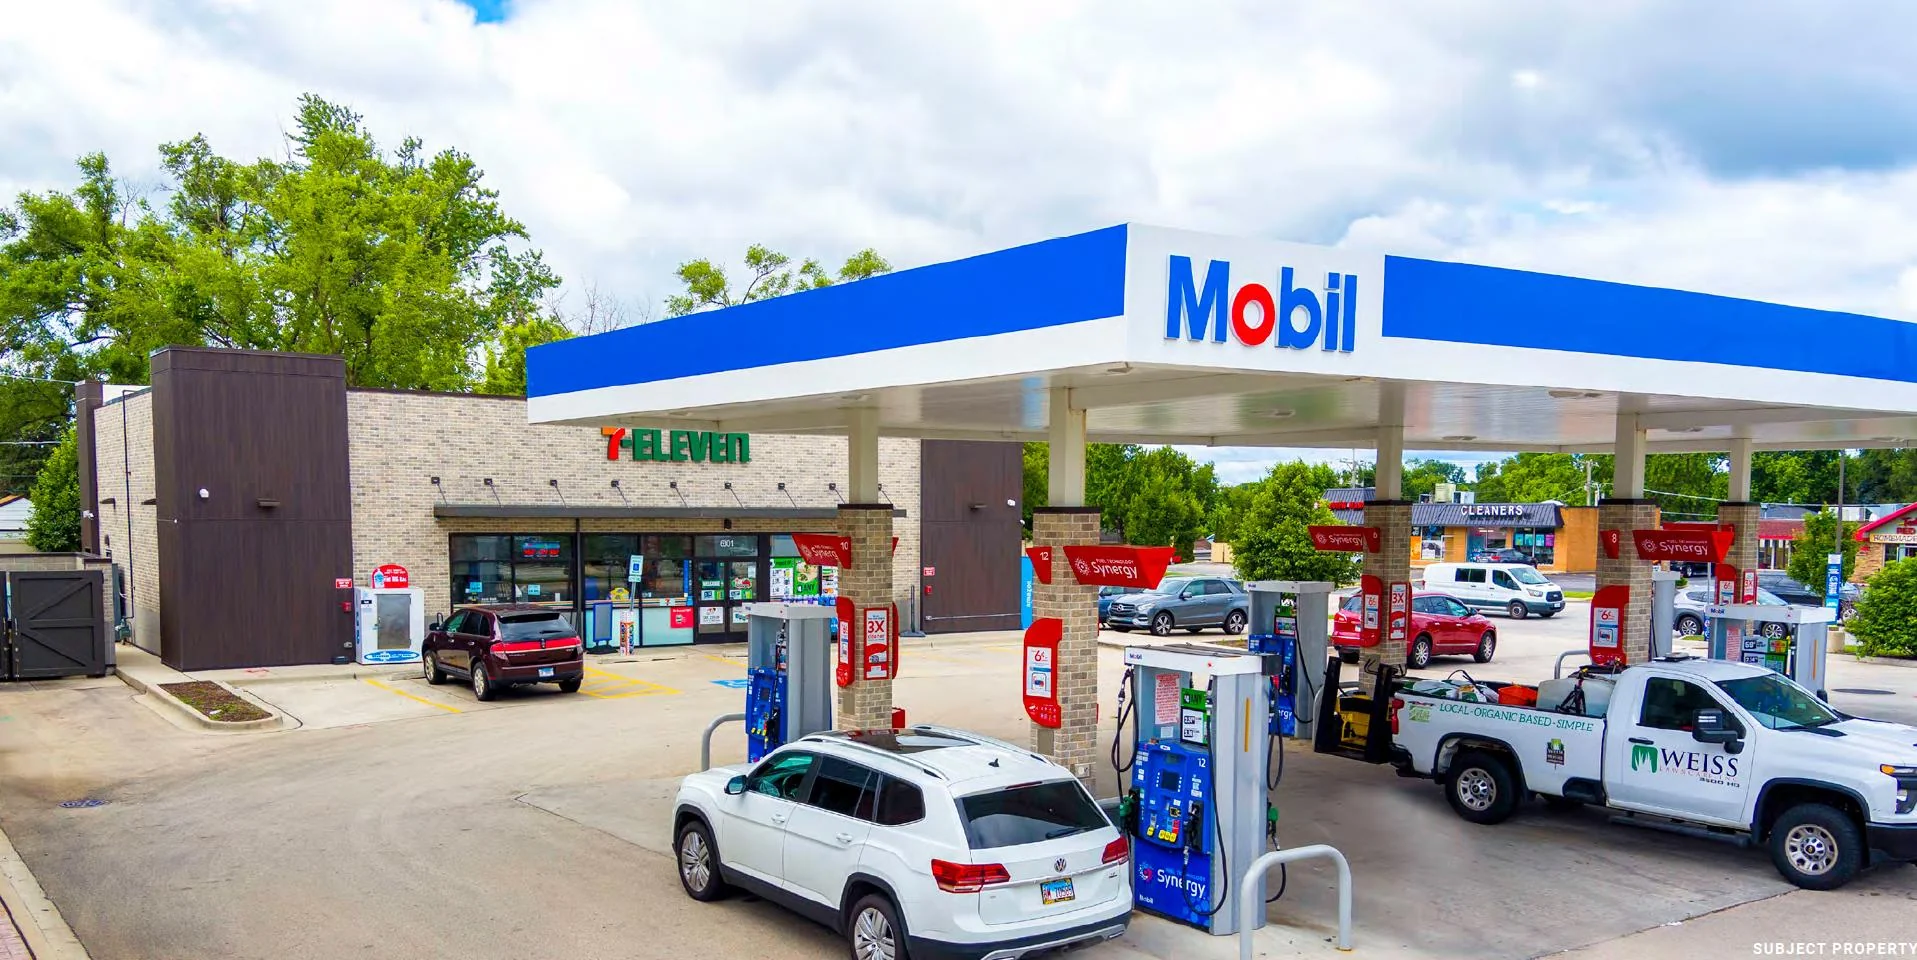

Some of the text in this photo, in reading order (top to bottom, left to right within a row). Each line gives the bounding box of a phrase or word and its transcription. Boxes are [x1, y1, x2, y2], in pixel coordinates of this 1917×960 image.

[1165, 254, 1358, 353] Mobil
[1460, 505, 1523, 516] CLEANERS
[1328, 534, 1363, 546] Synergy
[1611, 533, 1618, 544] 8
[840, 541, 849, 550] 10
[1659, 541, 1708, 556] Synergy
[811, 546, 838, 560] Synerg
[1039, 551, 1049, 561] 12
[1091, 561, 1138, 579] Synergy
[1392, 592, 1404, 604] 3X
[867, 620, 885, 633] 3X
[1198, 758, 1206, 768] 12
[1660, 748, 1739, 777] WEISS
[1699, 777, 1724, 785] 3500
[1157, 868, 1206, 899] Synergy
[1139, 894, 1154, 904] Mobil
